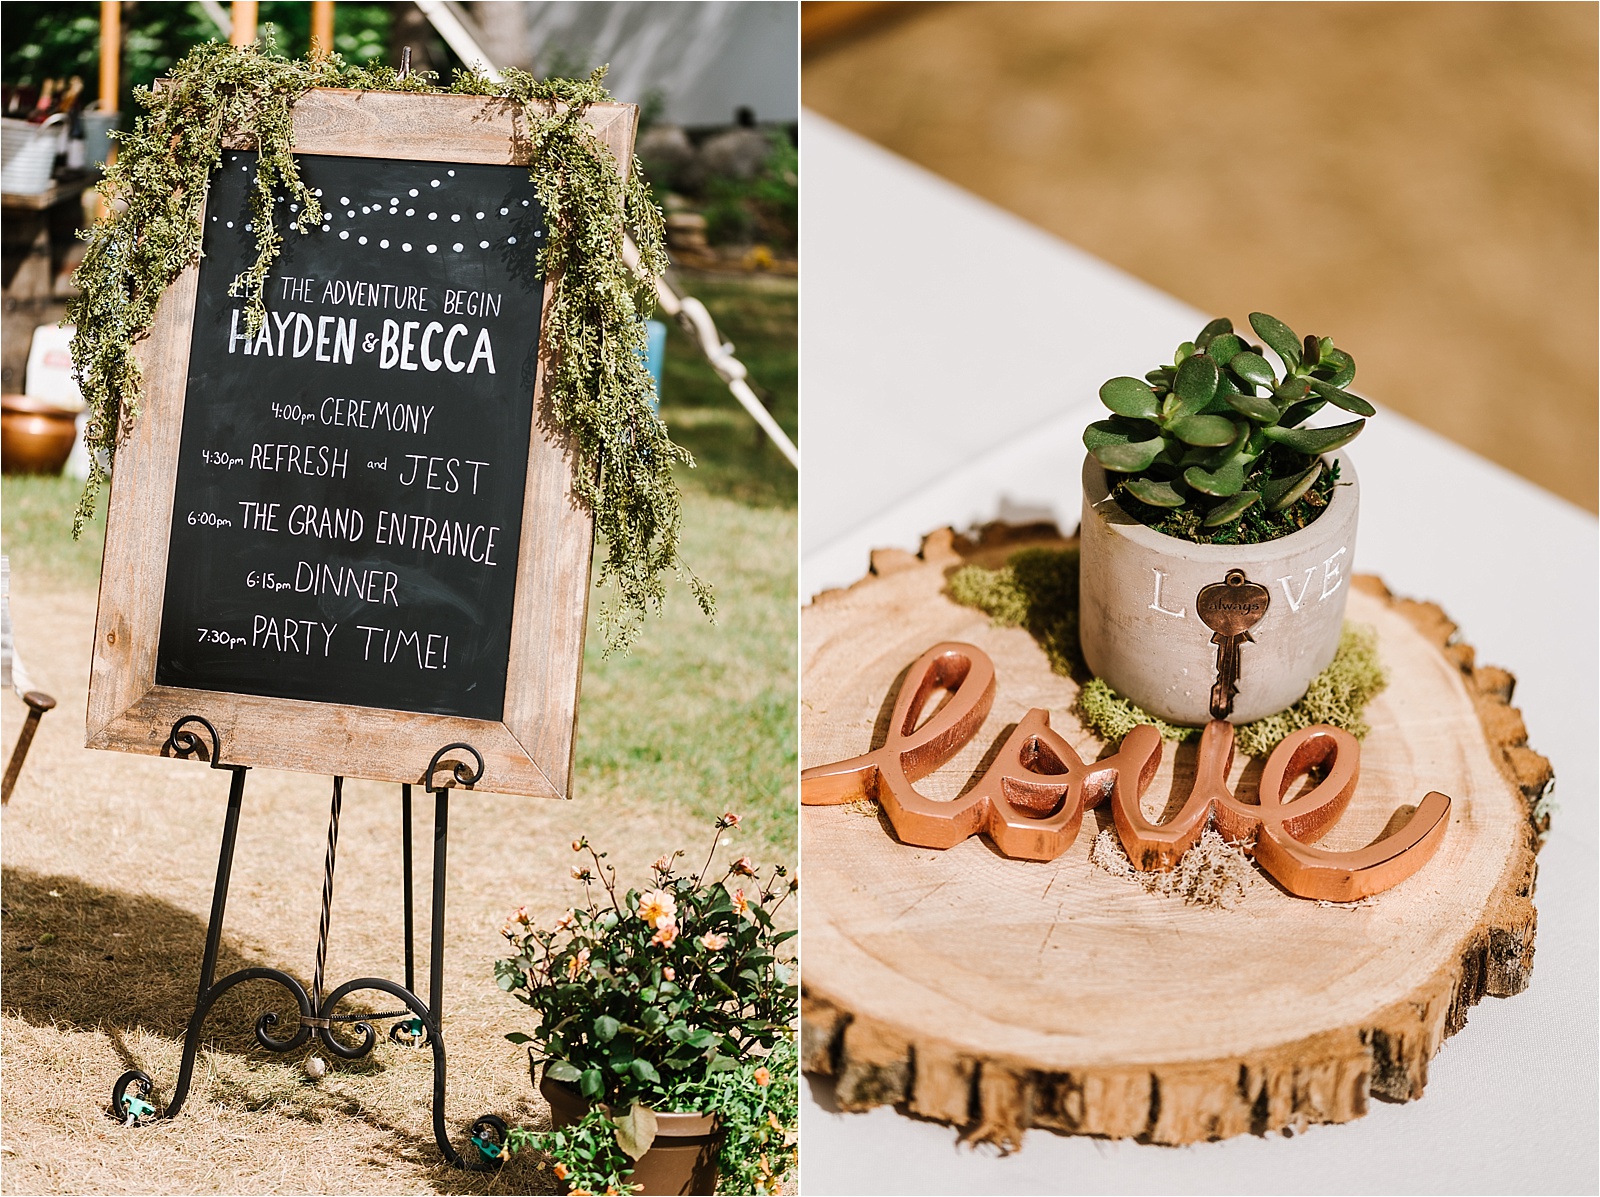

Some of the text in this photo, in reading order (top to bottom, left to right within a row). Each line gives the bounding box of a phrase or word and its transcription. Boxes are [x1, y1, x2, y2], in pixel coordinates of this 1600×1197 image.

[281, 276, 314, 303] THE
[321, 280, 428, 312] ADVENTURE
[443, 289, 502, 318] BEGIN
[228, 308, 496, 375] HAYDEN & BECCA
[271, 397, 435, 435] 4:00pm CEREMONY
[201, 443, 490, 495] 4:30pm REFRESH and JEST
[187, 501, 501, 567] 6:00pm THE GRAND ENTRANCE
[246, 561, 399, 608] 6:15pm DINNER
[1147, 545, 1348, 619] LVE
[1207, 600, 1260, 616] always
[197, 614, 450, 670] 7:30pm PARTY TIME!
[801, 641, 1452, 902] love
